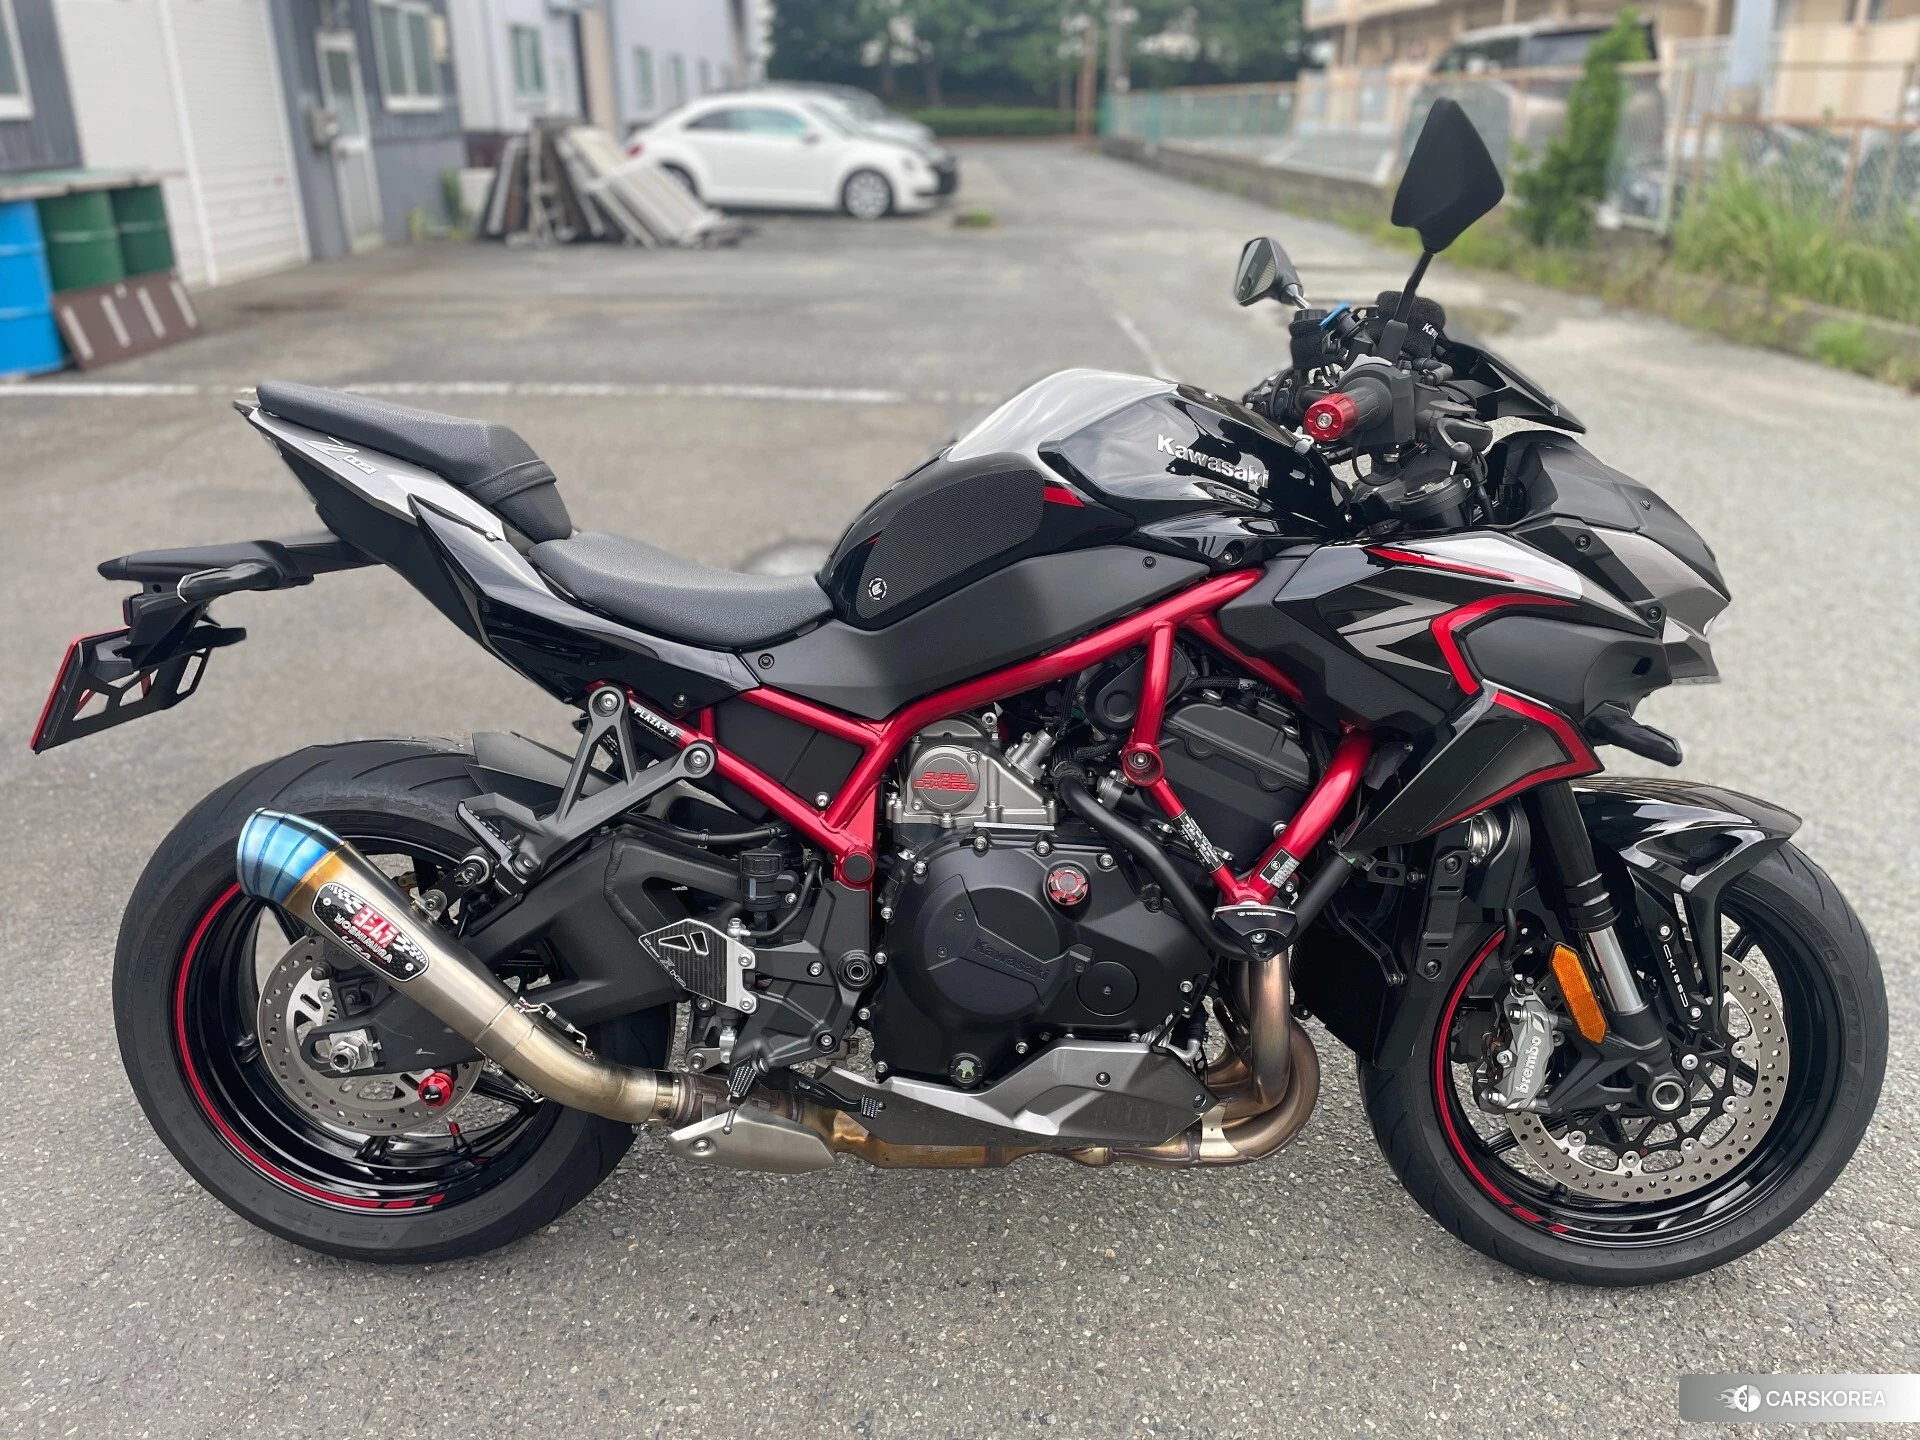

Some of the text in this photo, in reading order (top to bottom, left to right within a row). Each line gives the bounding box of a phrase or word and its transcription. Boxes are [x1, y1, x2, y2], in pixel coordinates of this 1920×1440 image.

[1157, 433, 1269, 488] Kawasaki
[913, 780, 977, 792] CHARGED
[921, 771, 968, 782] SUPER
[333, 912, 393, 964] YOSHIMURA
[341, 935, 372, 960] USA
[973, 939, 1051, 982] Kawasaki
[1514, 1035, 1542, 1094] brembo
